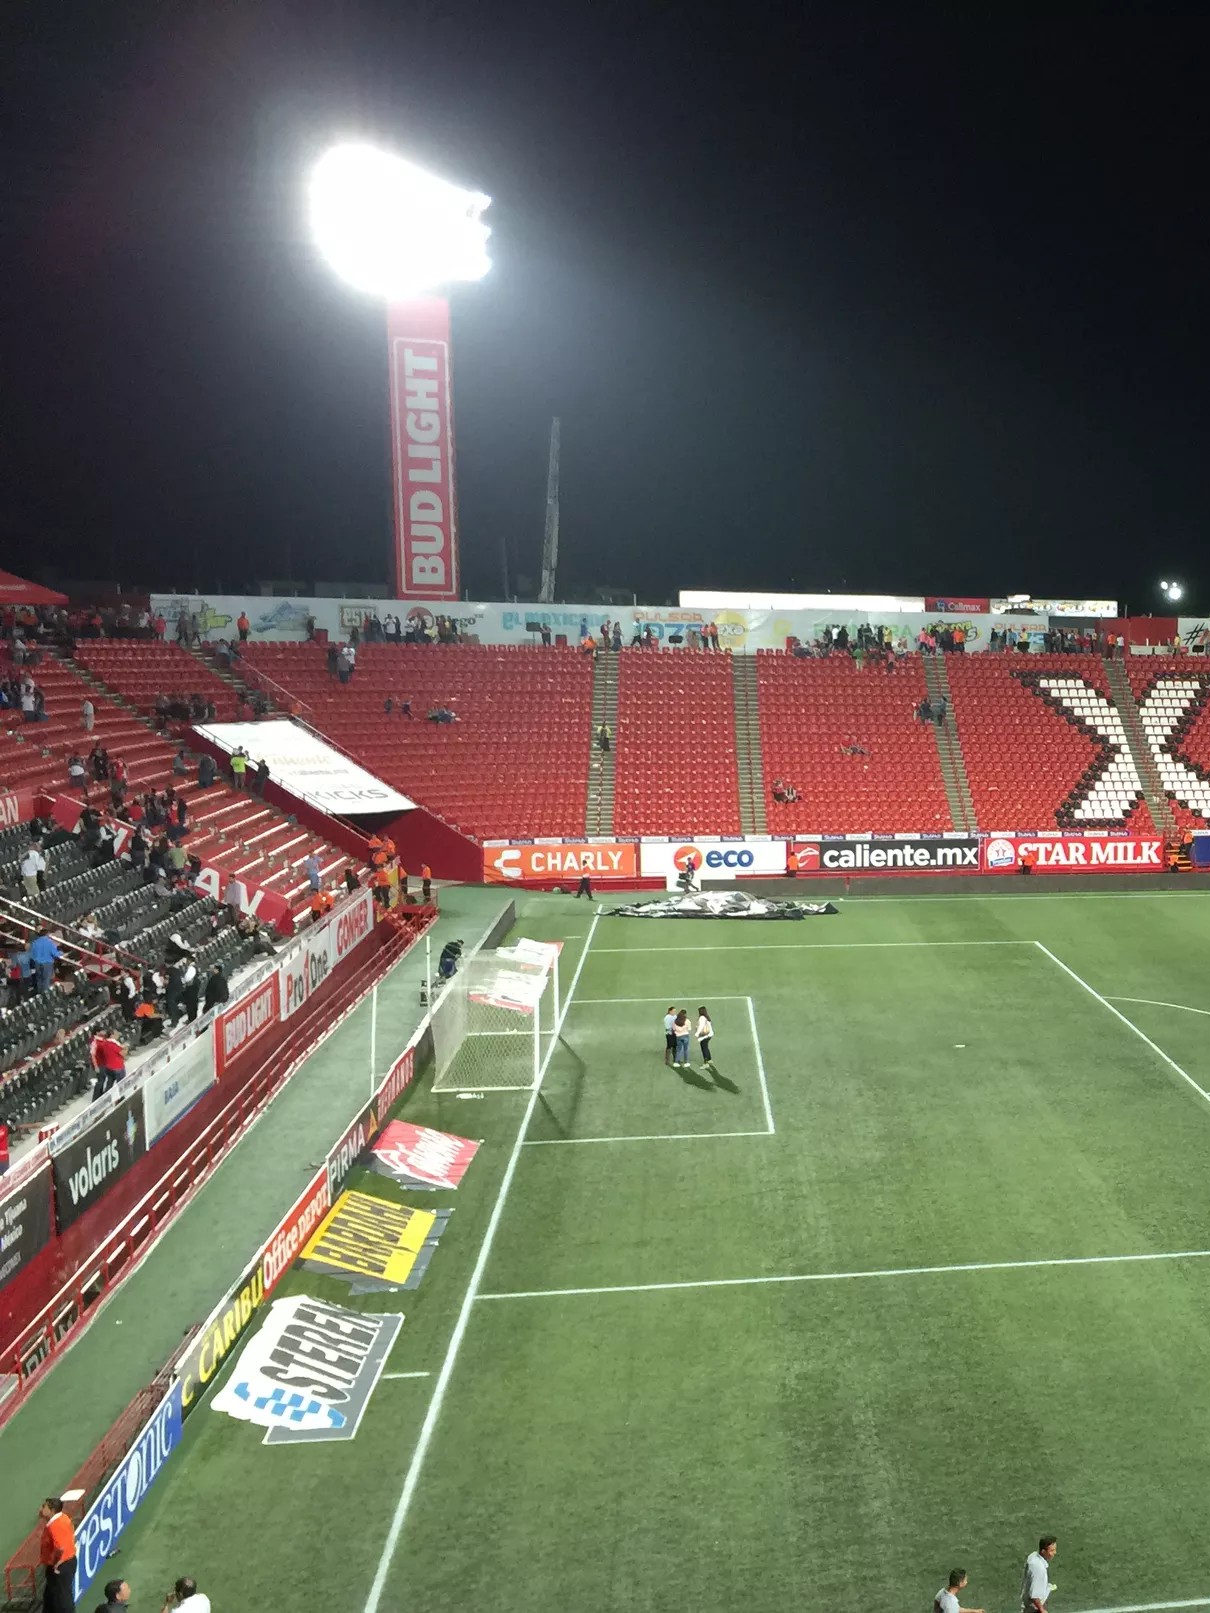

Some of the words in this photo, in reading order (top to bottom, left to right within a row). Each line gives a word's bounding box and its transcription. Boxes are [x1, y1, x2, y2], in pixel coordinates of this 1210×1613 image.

[404, 348, 442, 484] LIGHT
[410, 489, 446, 586] BUD
[947, 601, 981, 612] Calimax
[531, 850, 623, 872] CHARLY
[705, 848, 754, 868] eco
[823, 843, 979, 868] caliente.mx
[1018, 842, 1088, 866] STAR
[1090, 841, 1162, 865] MILK
[225, 1007, 247, 1056] BUD
[247, 985, 273, 1036] LIGHT
[68, 1129, 119, 1206] volaris
[329, 1121, 365, 1186] PIRMA
[263, 1223, 299, 1290] Office
[298, 1183, 330, 1243] DEPOT
[198, 1267, 264, 1384] CARIBU
[259, 1302, 384, 1402] STEREN
